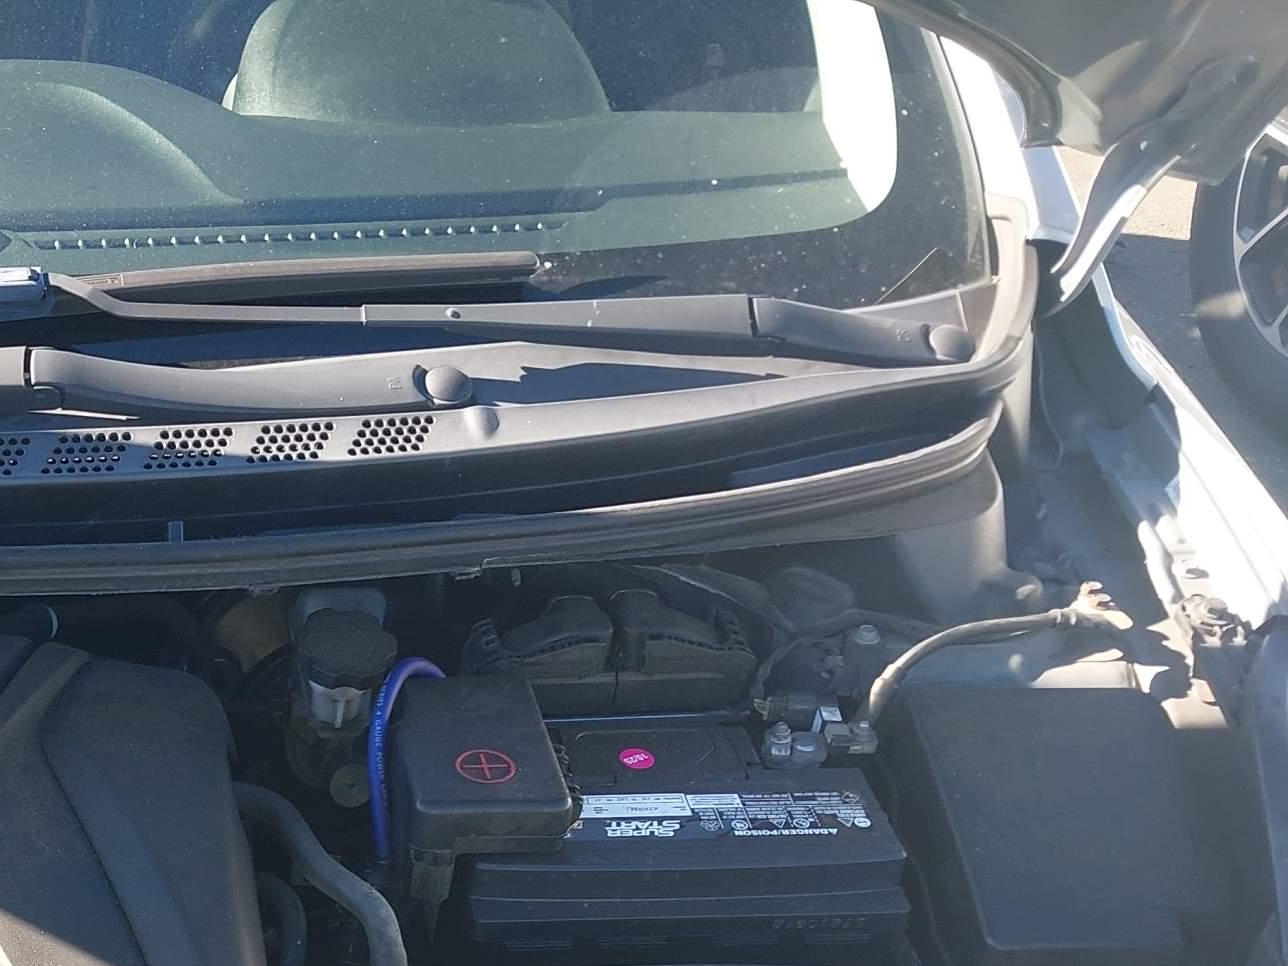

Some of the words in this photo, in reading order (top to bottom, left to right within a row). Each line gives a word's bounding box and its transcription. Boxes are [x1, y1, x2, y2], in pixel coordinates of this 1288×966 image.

[374, 719, 384, 747] GAUGE
[605, 819, 682, 830] START
[606, 828, 676, 837] SUPER
[734, 828, 829, 837] DANGER/POISON
